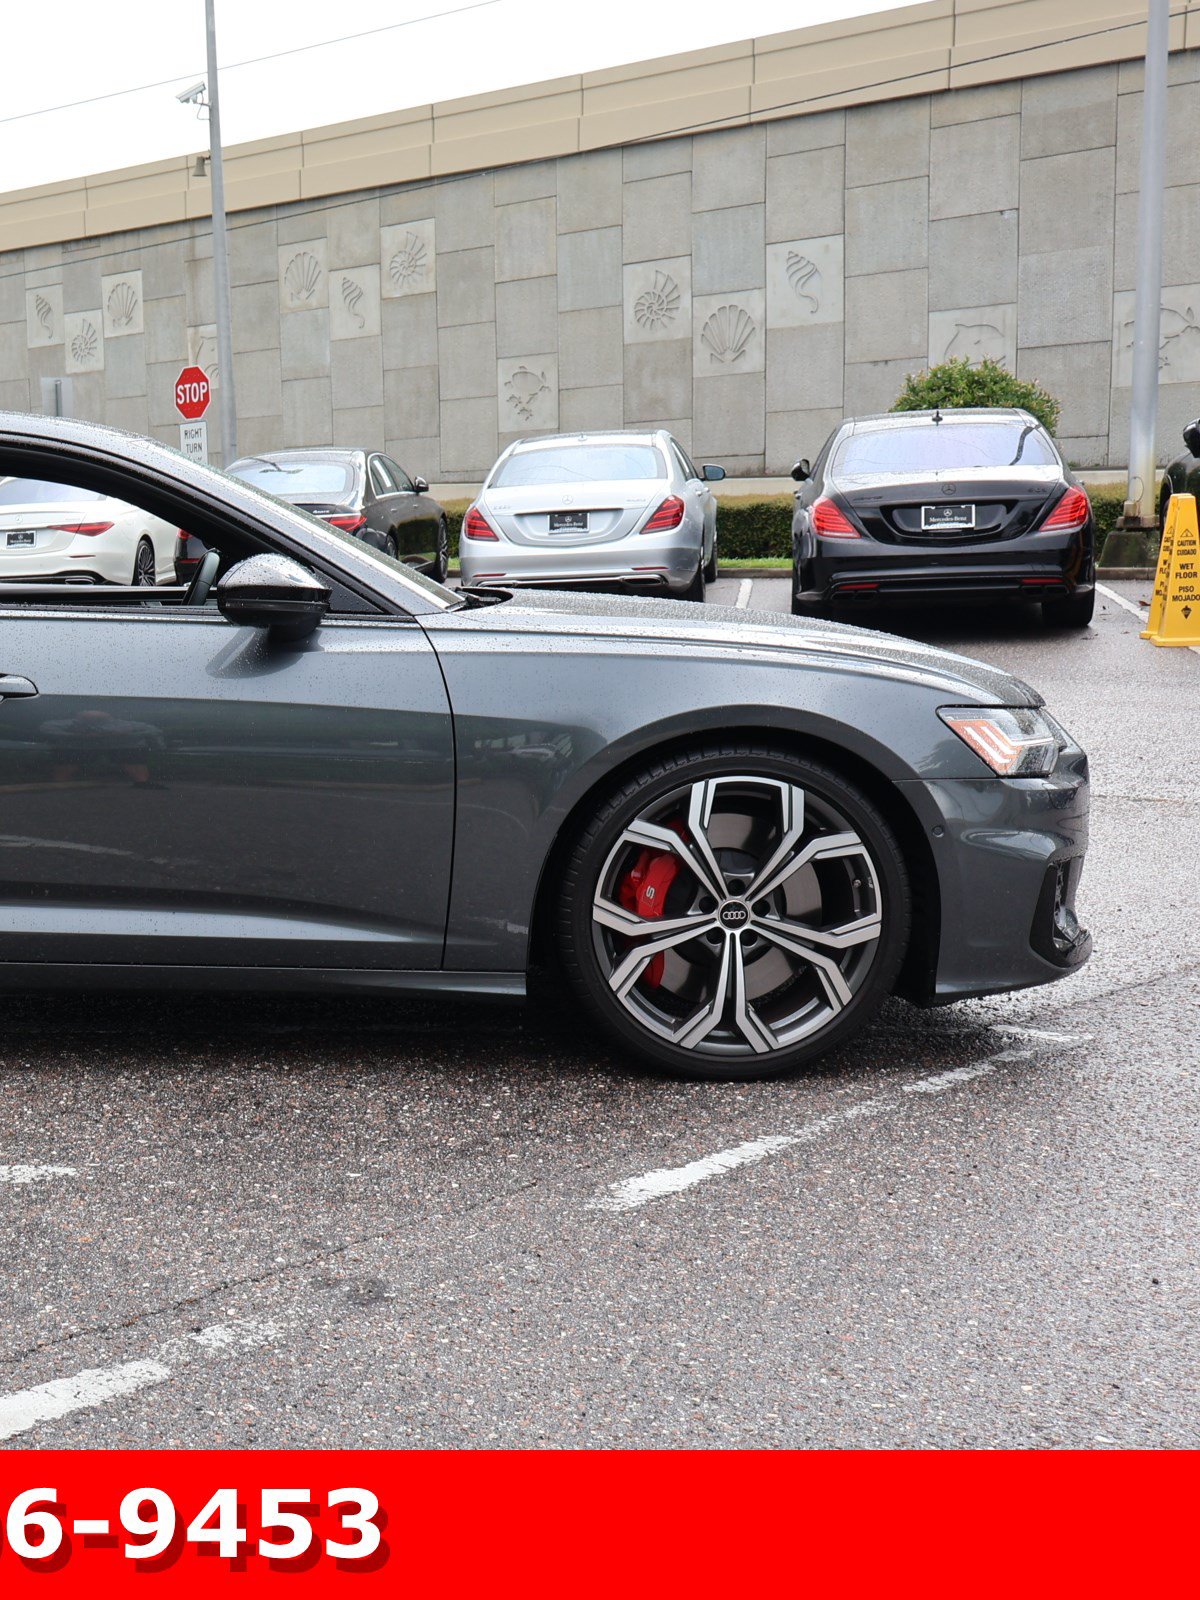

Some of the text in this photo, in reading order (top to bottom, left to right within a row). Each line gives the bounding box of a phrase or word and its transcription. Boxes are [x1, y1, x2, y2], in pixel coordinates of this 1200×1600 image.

[177, 382, 207, 404] STOP
[184, 428, 202, 439] RIGHT
[186, 443, 202, 453] TURN
[1172, 594, 1200, 602] MOJADO
